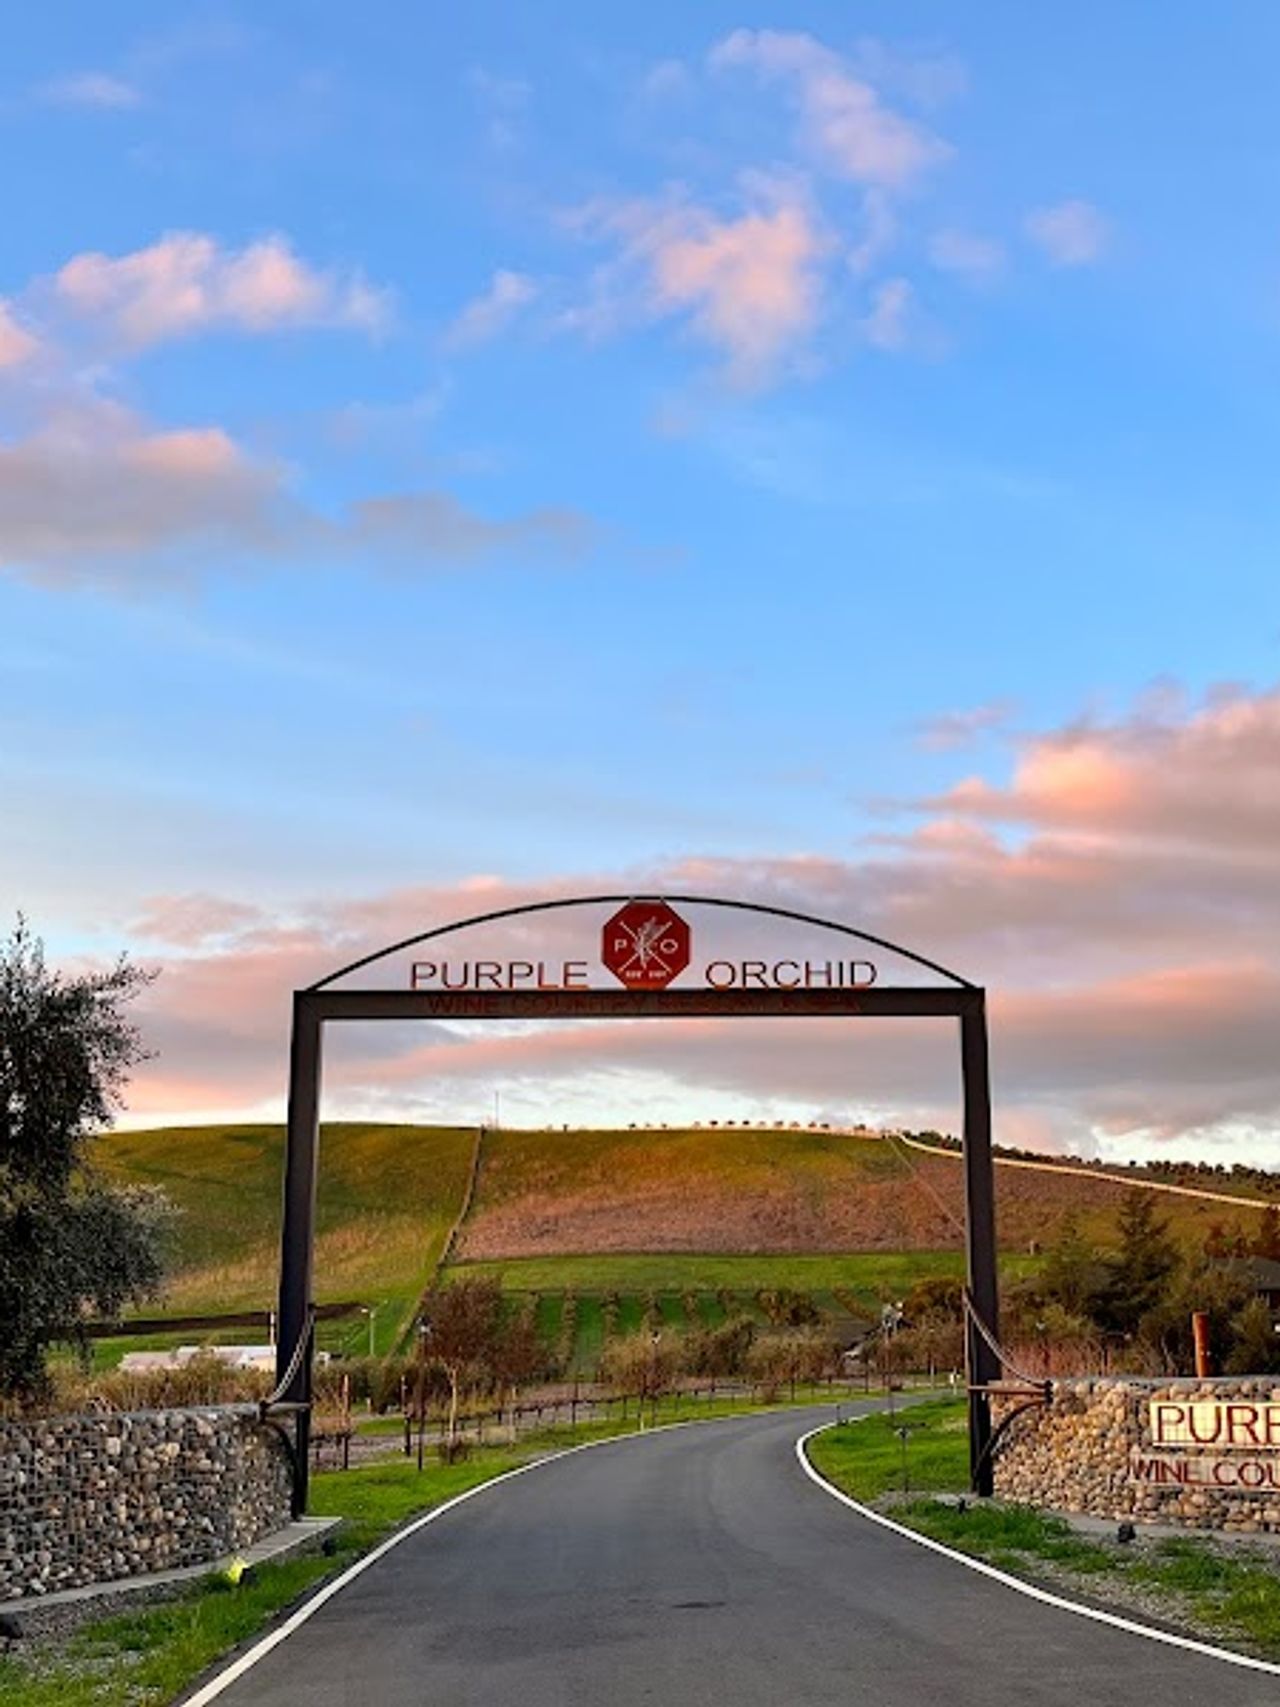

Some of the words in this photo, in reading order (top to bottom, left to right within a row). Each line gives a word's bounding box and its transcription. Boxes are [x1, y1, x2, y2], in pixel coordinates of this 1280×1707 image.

[614, 938, 628, 952] P
[411, 962, 589, 990] PURPLE
[705, 961, 877, 991] ORCHID
[427, 994, 499, 1013] WINE
